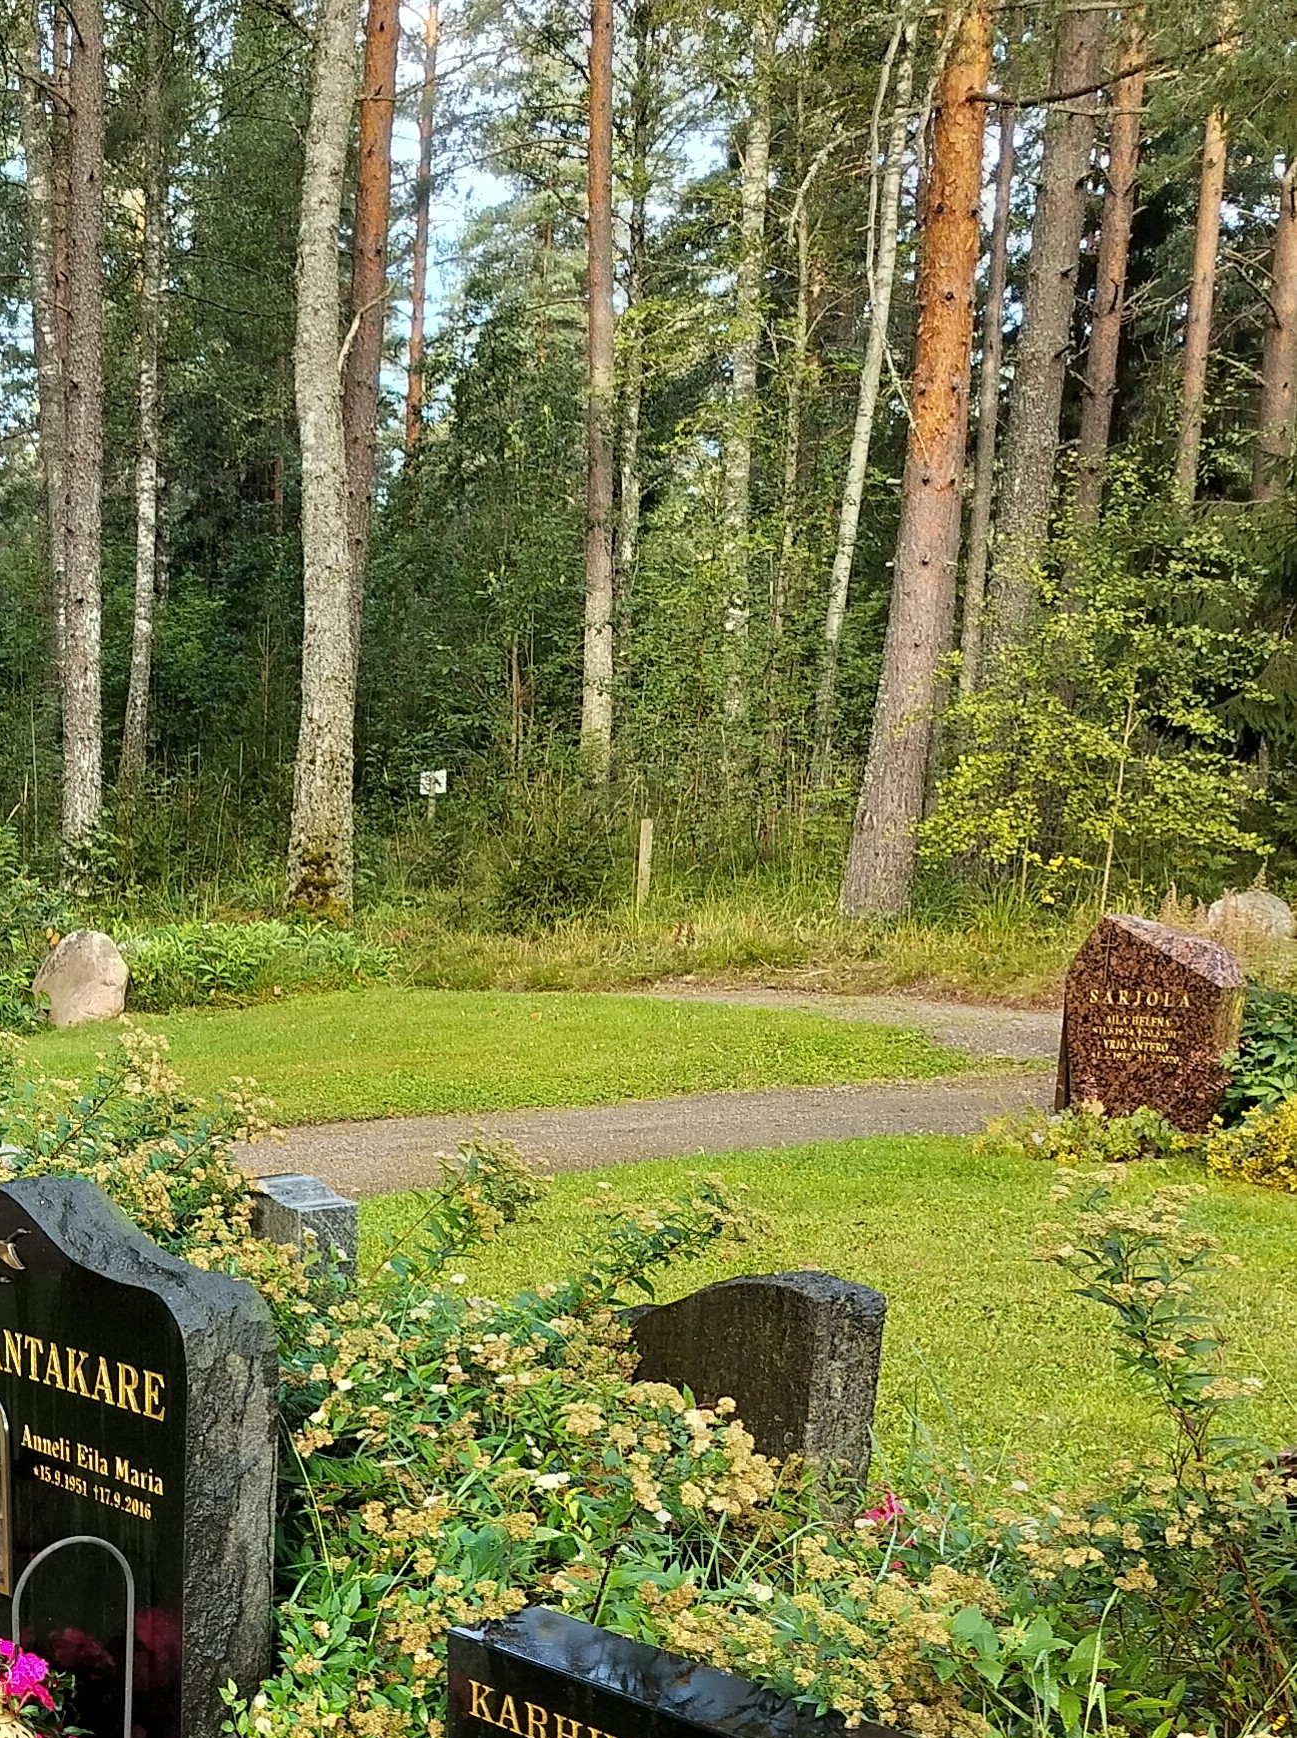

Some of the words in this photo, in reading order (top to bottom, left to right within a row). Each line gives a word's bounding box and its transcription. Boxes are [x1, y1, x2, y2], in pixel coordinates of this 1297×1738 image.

[1089, 989, 1190, 1008] SARJOLA
[1132, 1015, 1170, 1027] HELENA
[1130, 1040, 1169, 1053] ANTERO
[20, 1424, 71, 1463] Anneli
[76, 1442, 109, 1477] Eila
[114, 1455, 164, 1497] Maria
